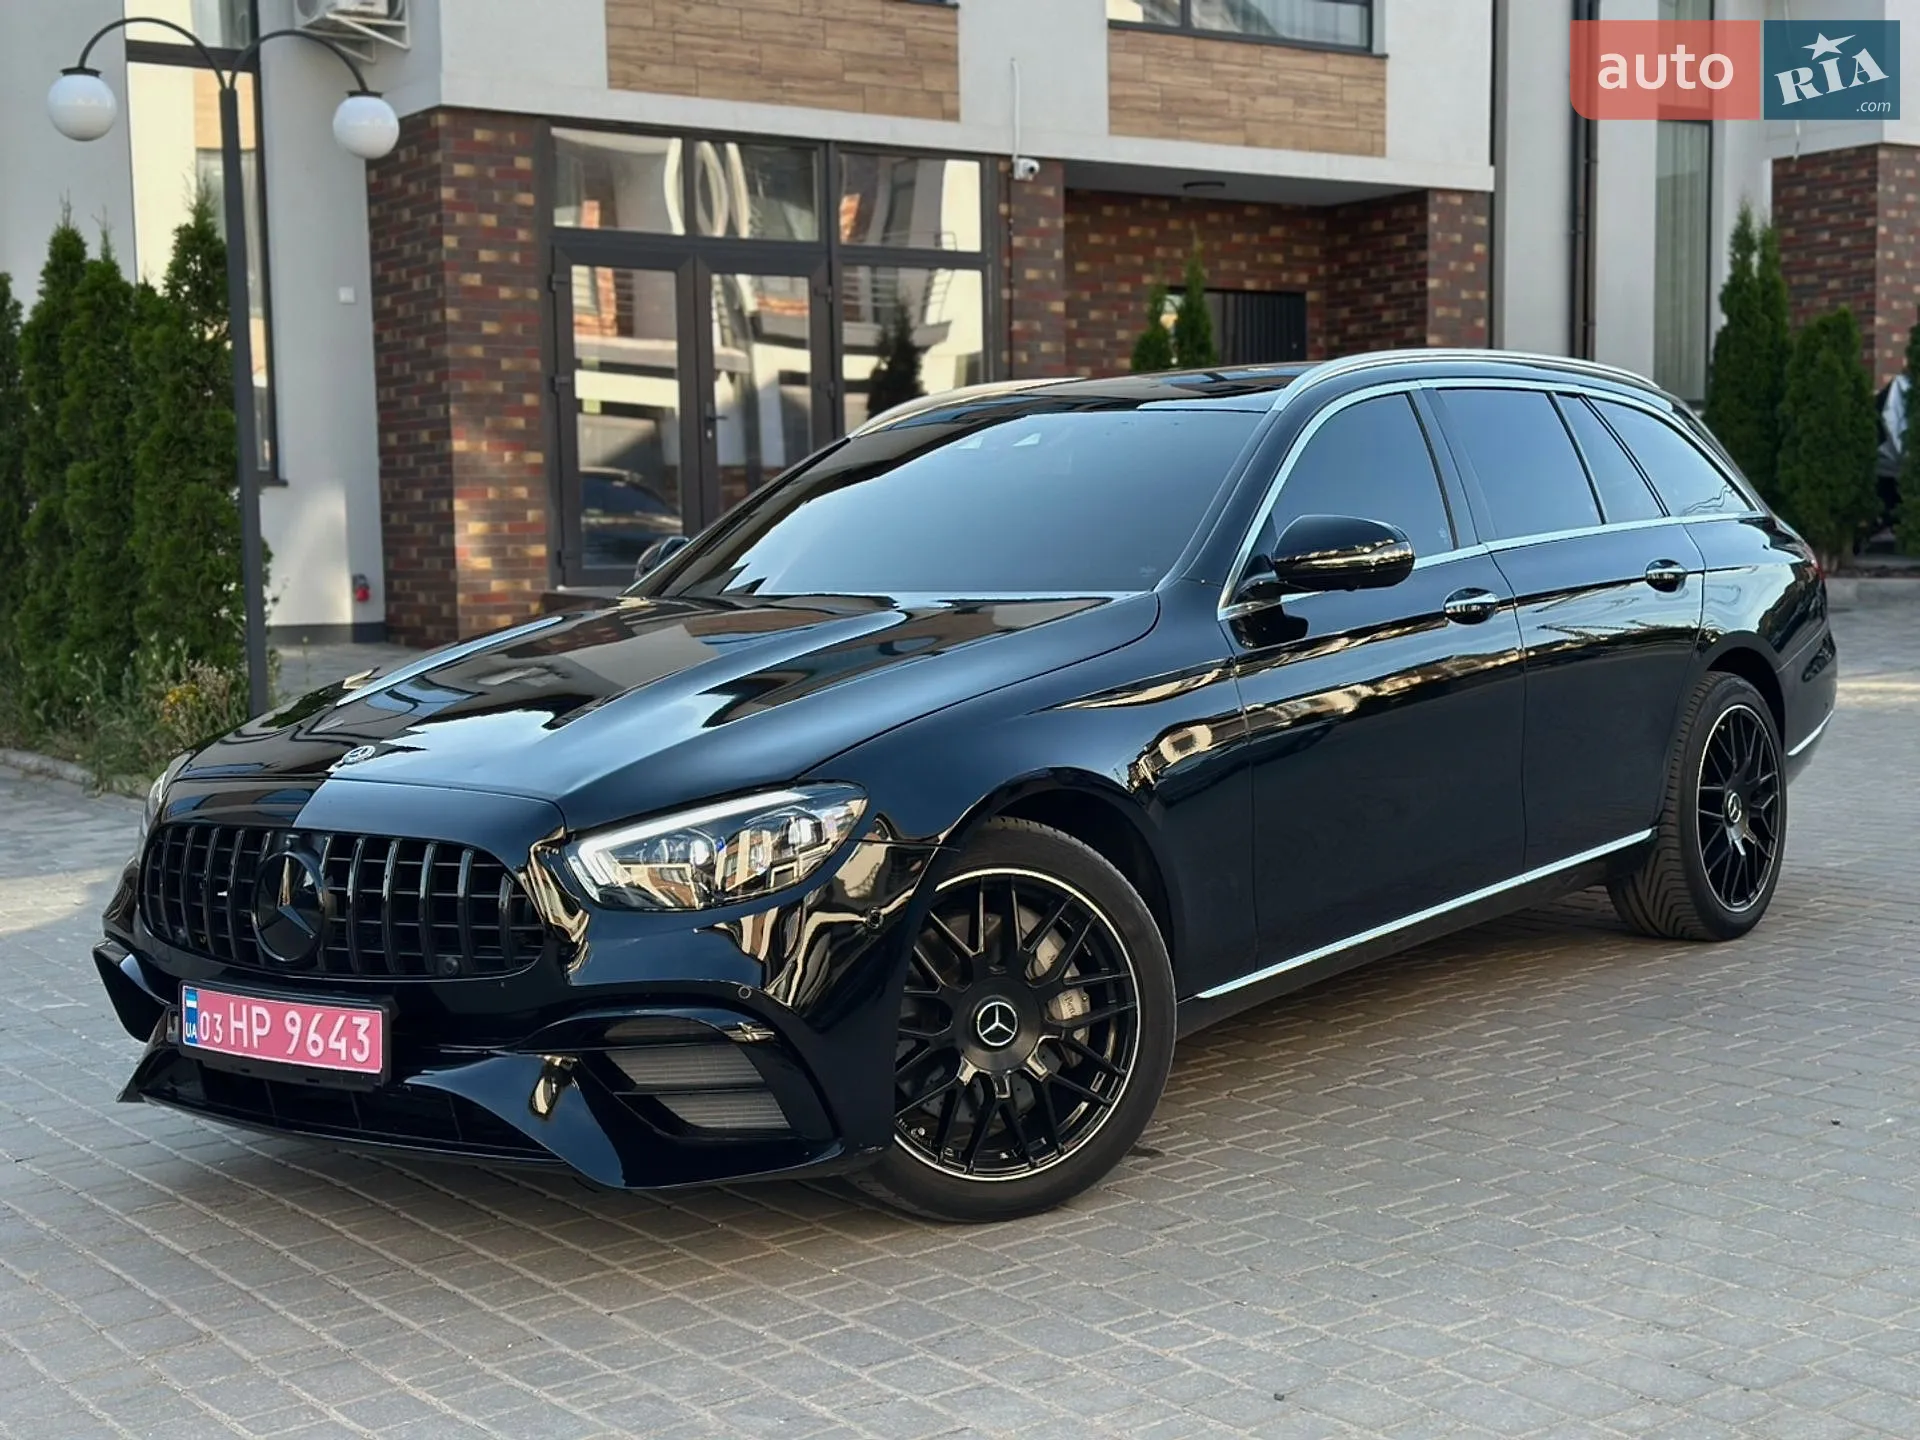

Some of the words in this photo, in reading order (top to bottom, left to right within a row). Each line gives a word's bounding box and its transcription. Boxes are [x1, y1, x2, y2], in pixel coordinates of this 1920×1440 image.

[185, 1022, 198, 1039] UA
[199, 1012, 223, 1044] 03
[229, 1001, 272, 1049] HP
[284, 1009, 371, 1063] 9643
